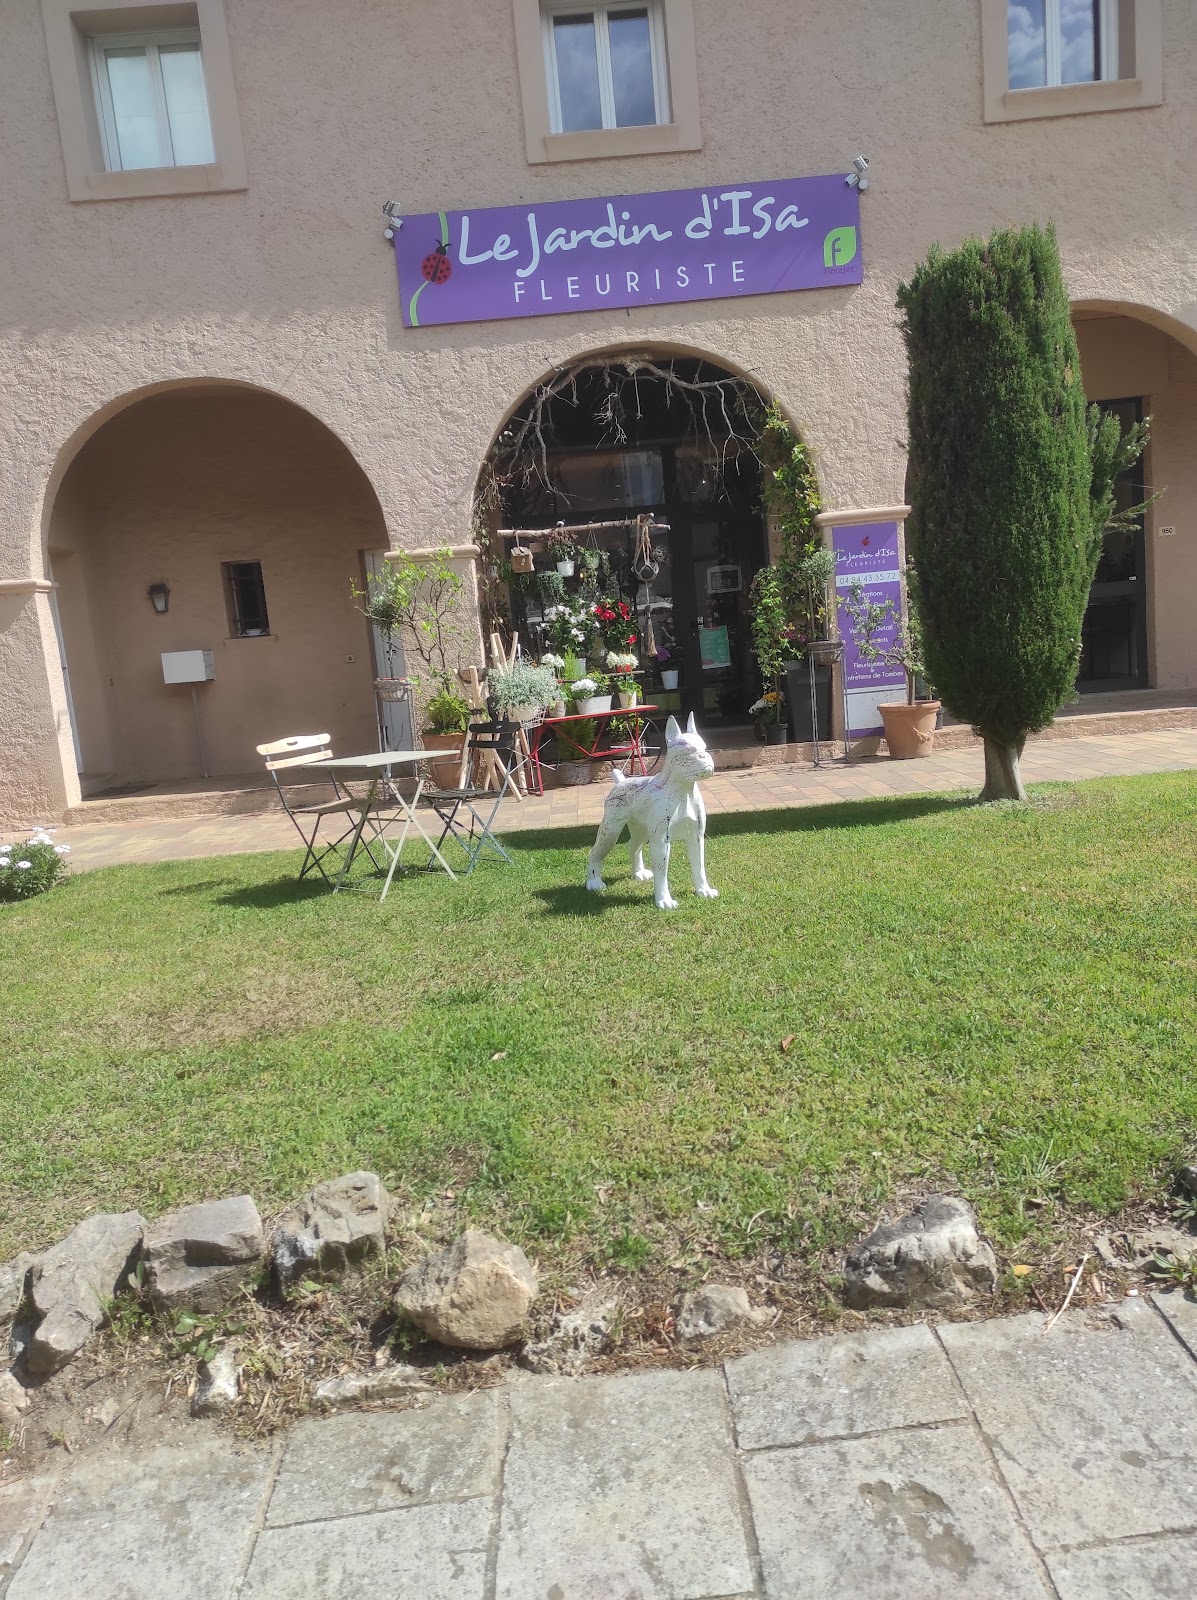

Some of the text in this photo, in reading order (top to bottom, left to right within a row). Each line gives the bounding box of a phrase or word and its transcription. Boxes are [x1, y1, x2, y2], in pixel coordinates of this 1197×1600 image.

[459, 216, 518, 265] Le
[516, 203, 672, 277] Jardin
[514, 260, 745, 303] FLEURISTE
[1161, 527, 1173, 535] 950
[837, 552, 847, 562] Le
[846, 550, 874, 563] Jardin
[839, 577, 849, 585] 04
[863, 574, 873, 582] 43
[874, 573, 885, 581] 35
[886, 572, 896, 580] 72
